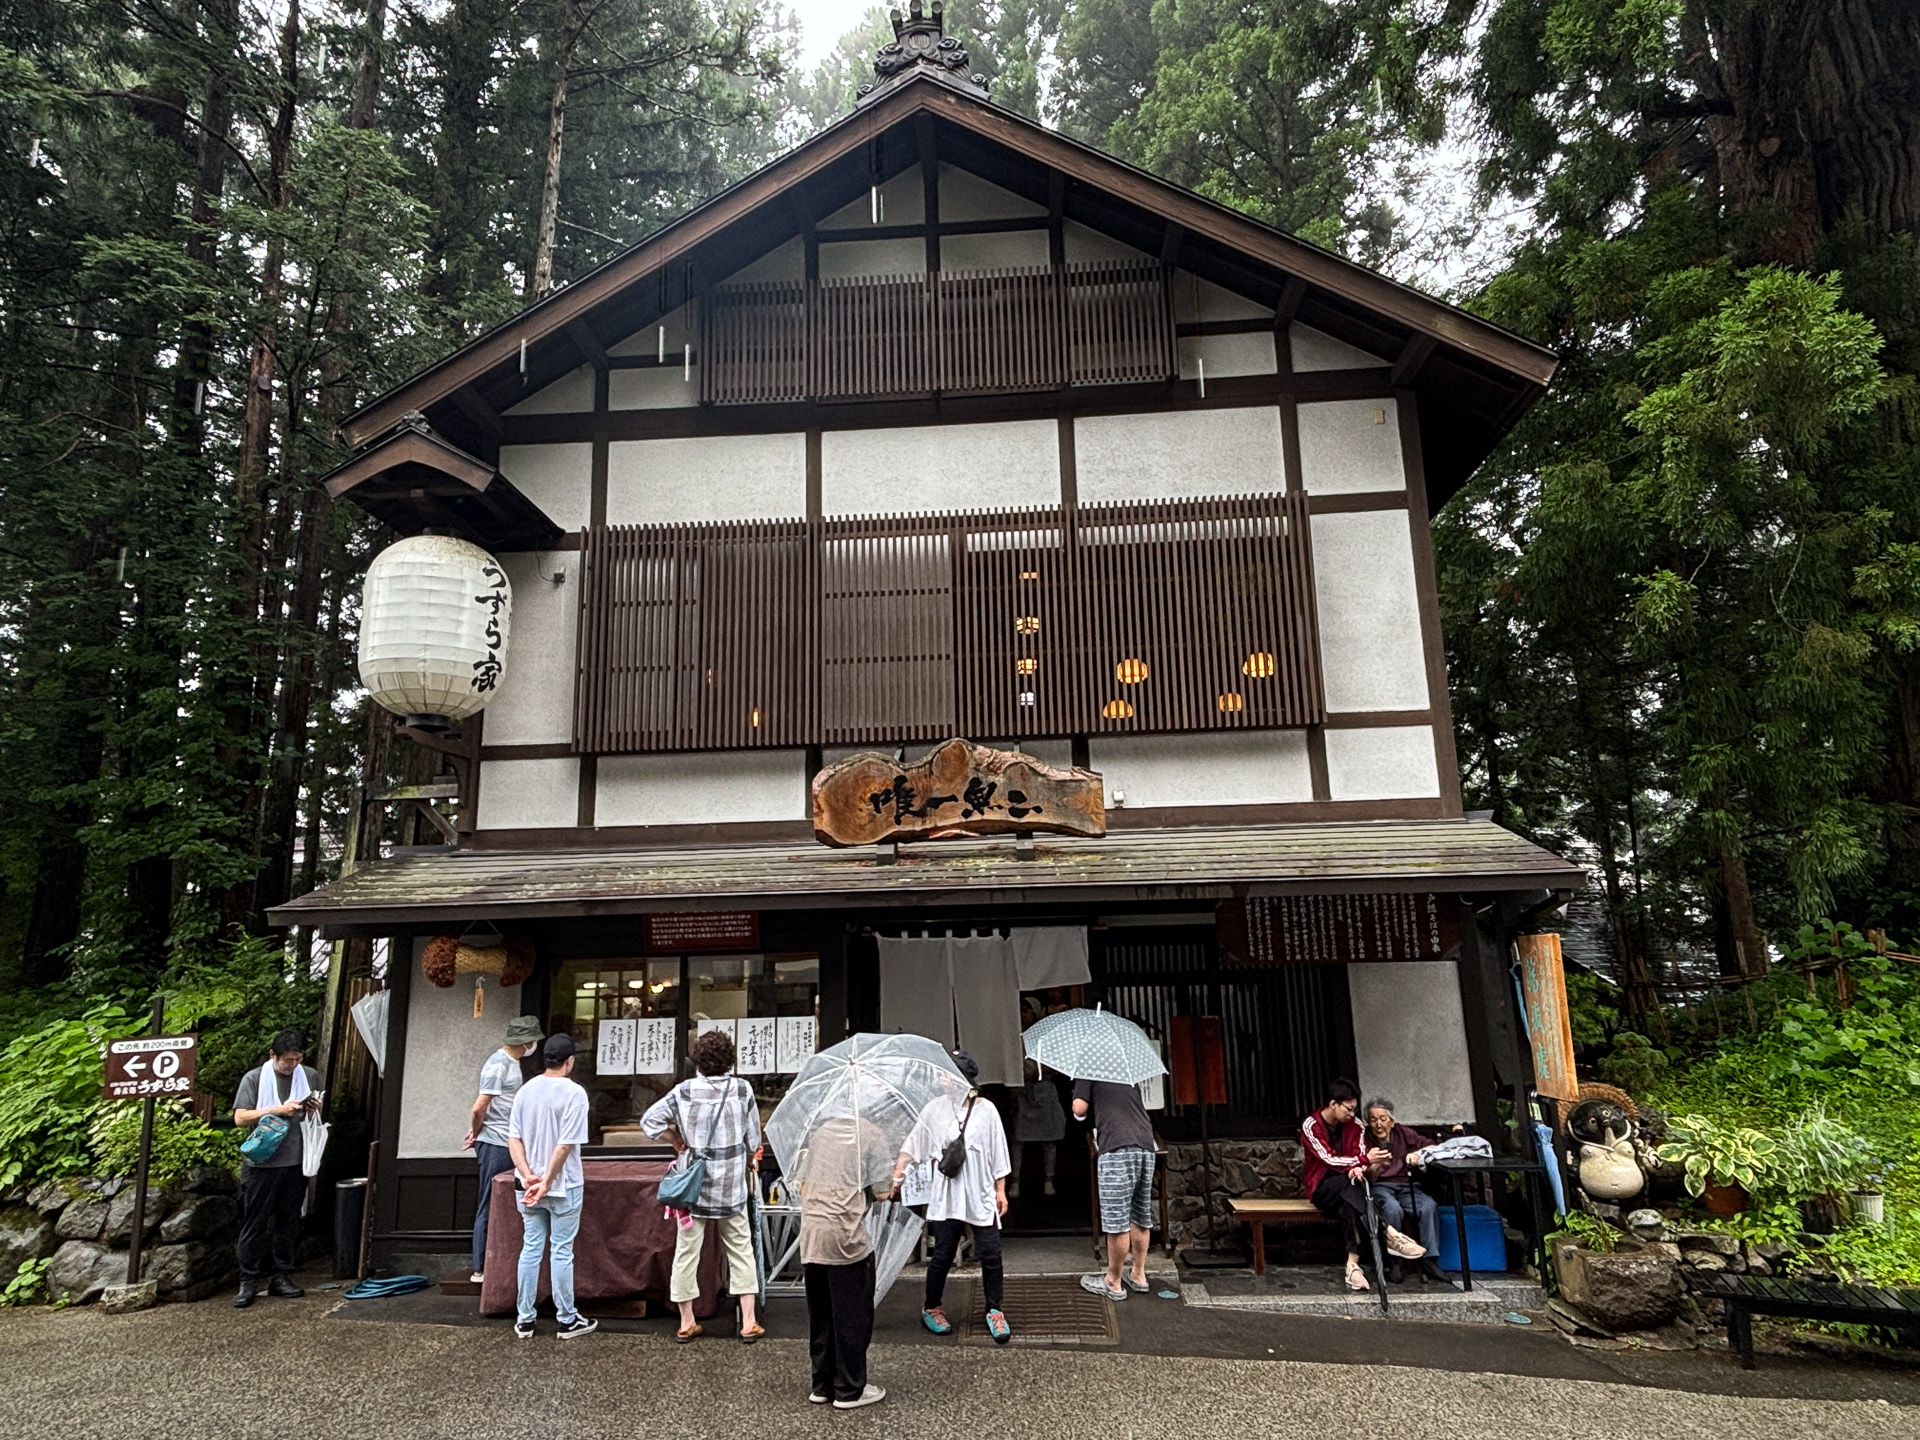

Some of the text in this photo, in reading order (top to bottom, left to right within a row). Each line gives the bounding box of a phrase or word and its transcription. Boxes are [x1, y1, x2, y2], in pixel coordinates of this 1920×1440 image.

[471, 557, 507, 693] うずら家
[118, 1043, 140, 1051] この先
[160, 1056, 174, 1074] P
[138, 1078, 190, 1093] うずら家
